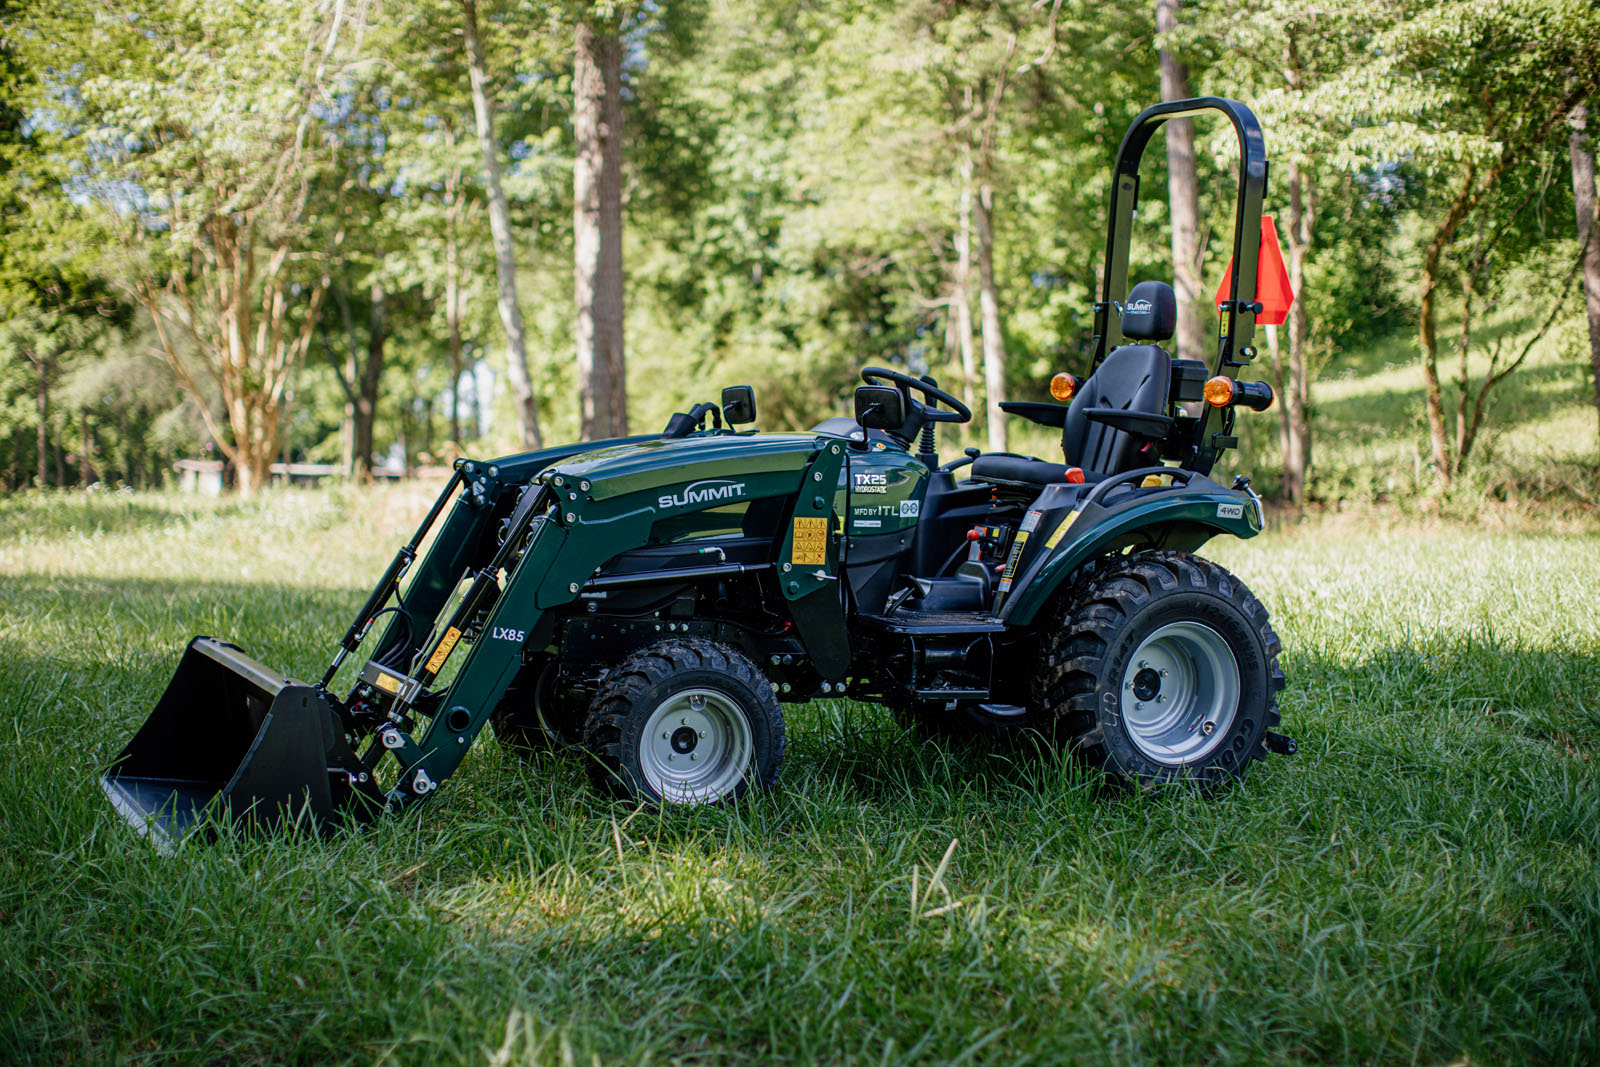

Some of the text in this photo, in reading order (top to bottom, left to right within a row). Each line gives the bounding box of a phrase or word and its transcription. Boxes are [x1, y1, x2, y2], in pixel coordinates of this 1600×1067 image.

[1127, 299, 1153, 311] SUMMIT
[854, 474, 886, 484] TX25
[658, 480, 746, 508] SUMMIT
[854, 505, 899, 516] MFD BY ITL
[1221, 506, 1241, 516] 4WD
[492, 626, 525, 642] LX85
